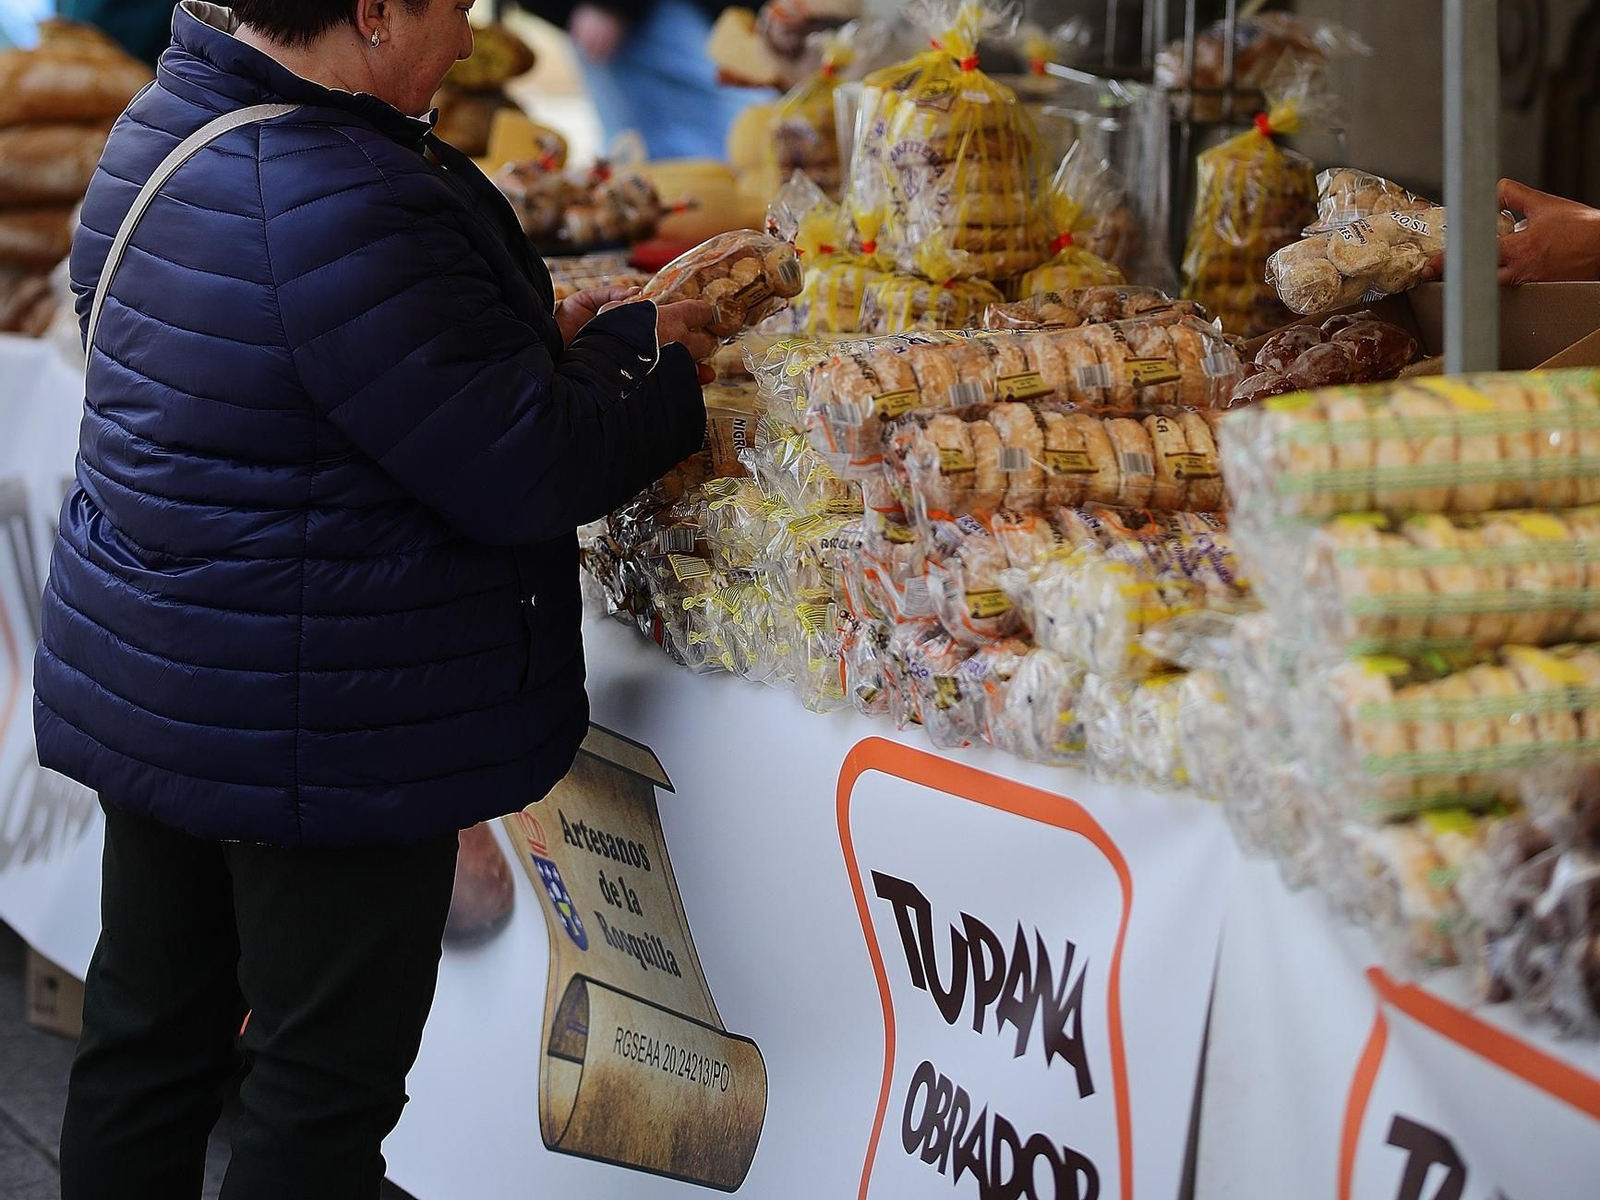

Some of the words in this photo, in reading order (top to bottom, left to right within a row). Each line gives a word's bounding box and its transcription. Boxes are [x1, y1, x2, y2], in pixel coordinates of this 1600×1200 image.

[558, 809, 651, 872] Artesanos
[600, 869, 621, 908] de
[619, 876, 643, 917] la
[595, 910, 682, 979] Rosquilla
[870, 869, 1095, 1098] TUPANA
[613, 1026, 660, 1069] RGSEAA
